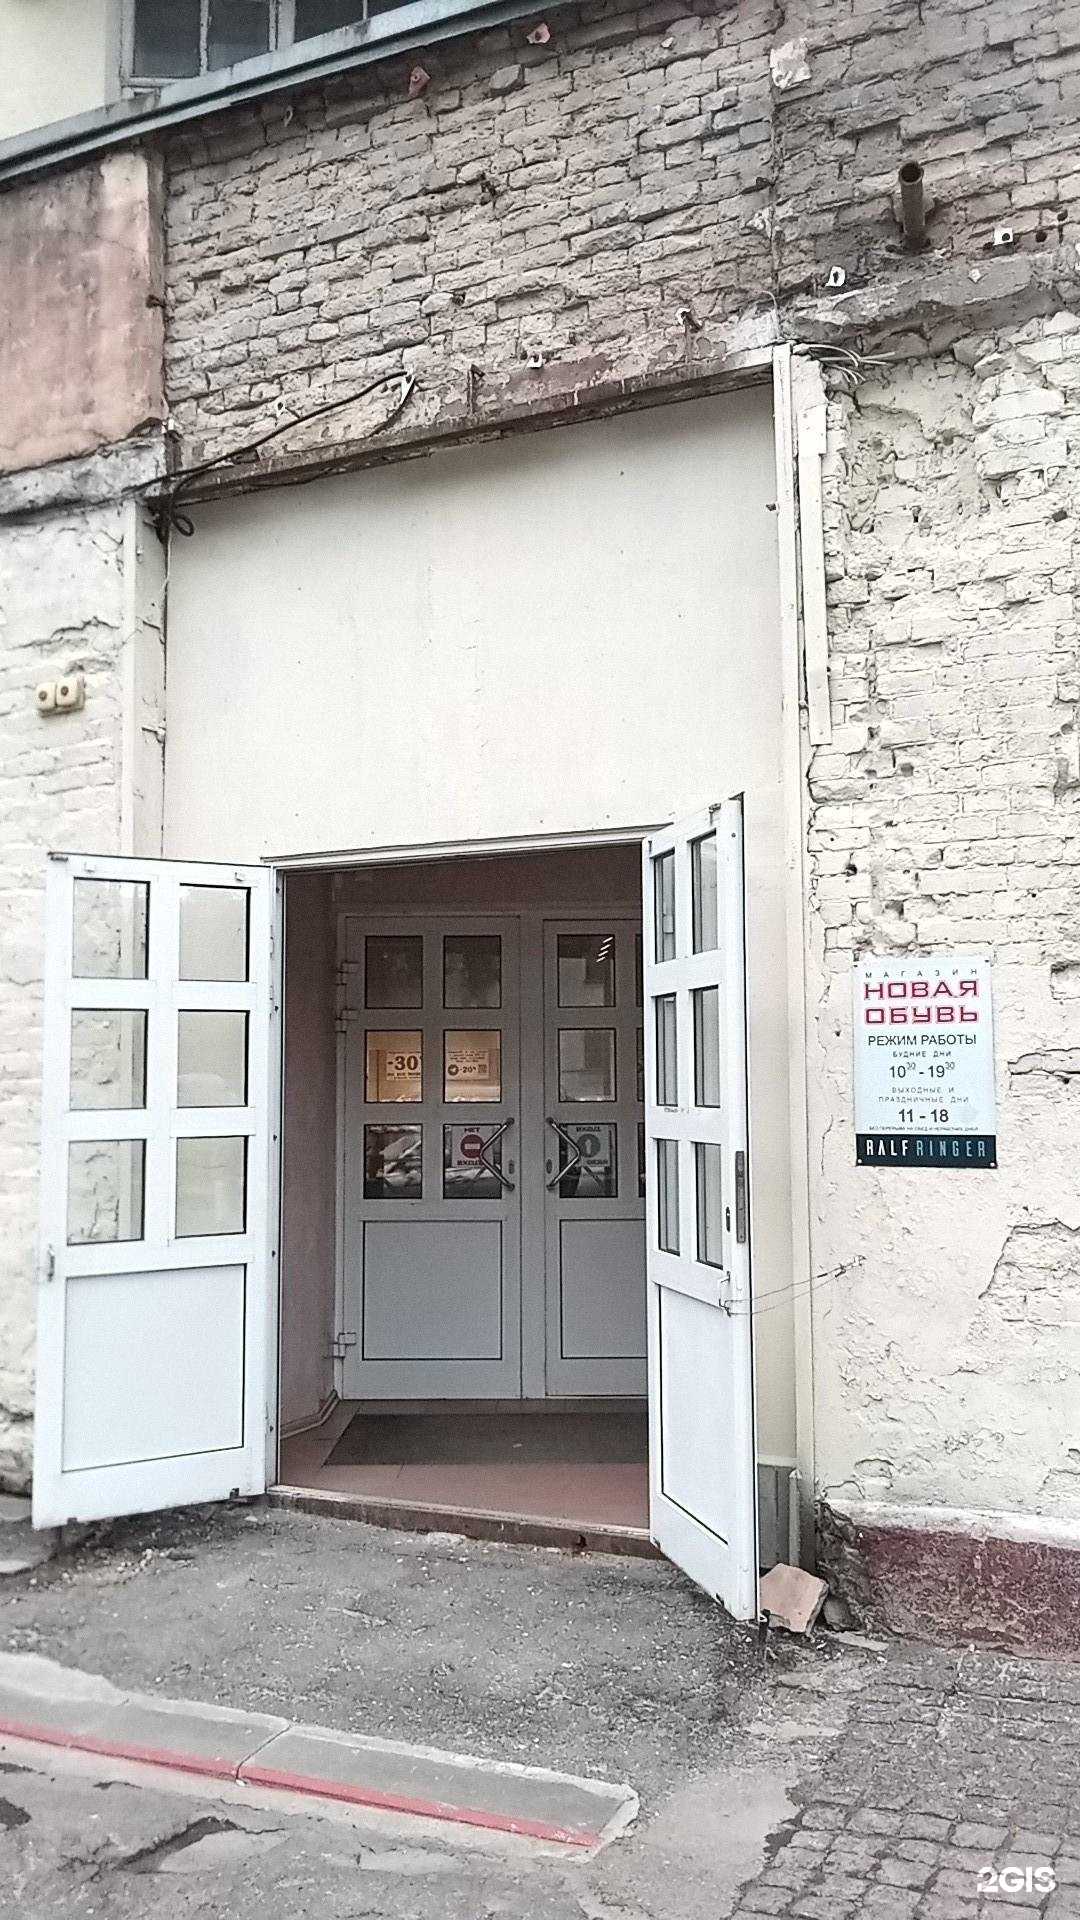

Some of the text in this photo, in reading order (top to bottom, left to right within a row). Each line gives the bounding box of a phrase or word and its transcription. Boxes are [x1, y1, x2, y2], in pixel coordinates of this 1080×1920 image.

[865, 969, 978, 979] МАГАЗИН
[864, 980, 978, 999] НОВАЯ
[865, 1006, 978, 1024] ОБУВЬ
[868, 1034, 977, 1046] РЕЖИМ РАБОТЫ
[933, 1050, 952, 1058] ДНИ
[388, 1055, 421, 1070] -30
[898, 1109, 914, 1122] 11
[930, 1109, 949, 1122] 18
[866, 1139, 986, 1158] RALF RINGER
